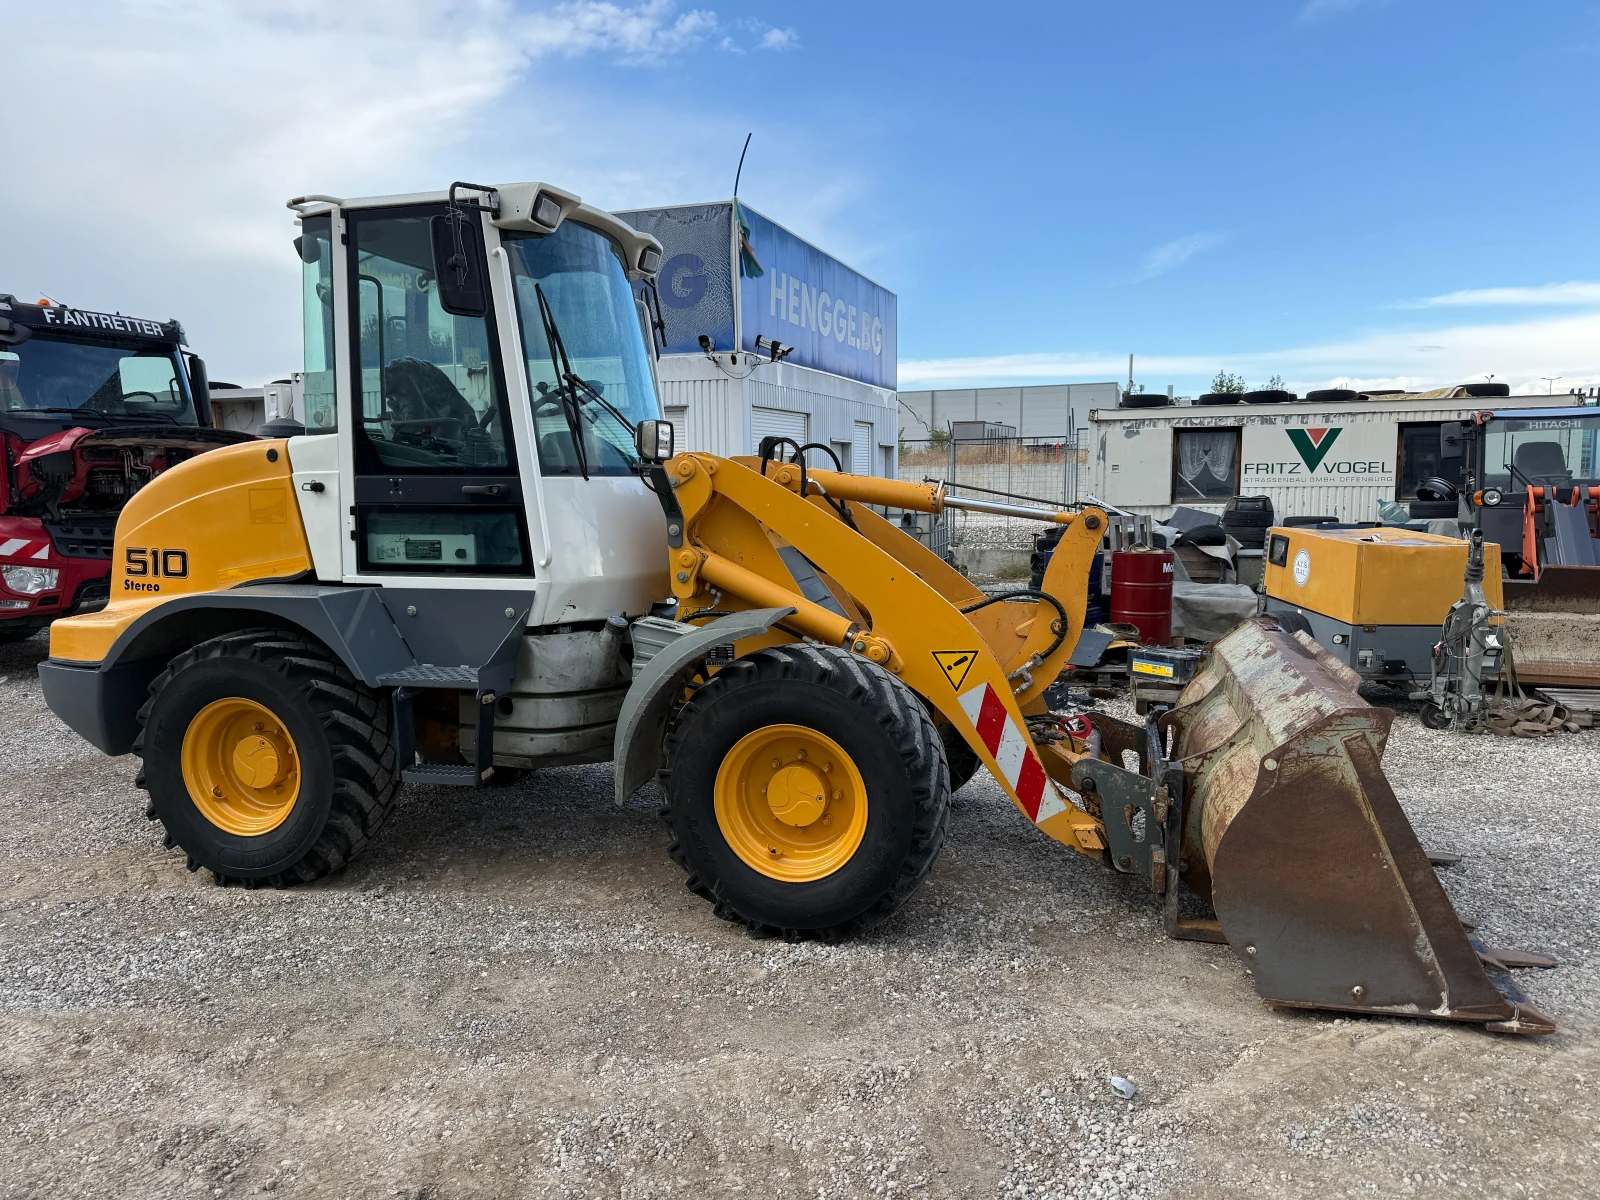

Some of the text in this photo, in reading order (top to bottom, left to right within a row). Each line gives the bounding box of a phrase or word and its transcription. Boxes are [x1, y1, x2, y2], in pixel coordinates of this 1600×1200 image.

[632, 253, 708, 310] G
[770, 267, 883, 356] HENGGE.BG
[43, 308, 164, 336] F. ANTRETTER
[1529, 420, 1581, 429] HITACHI
[1244, 462, 1393, 474] FRITZ VOGEL
[125, 547, 190, 579] 510
[1163, 562, 1175, 573] Mo
[124, 579, 160, 592] Stereo
